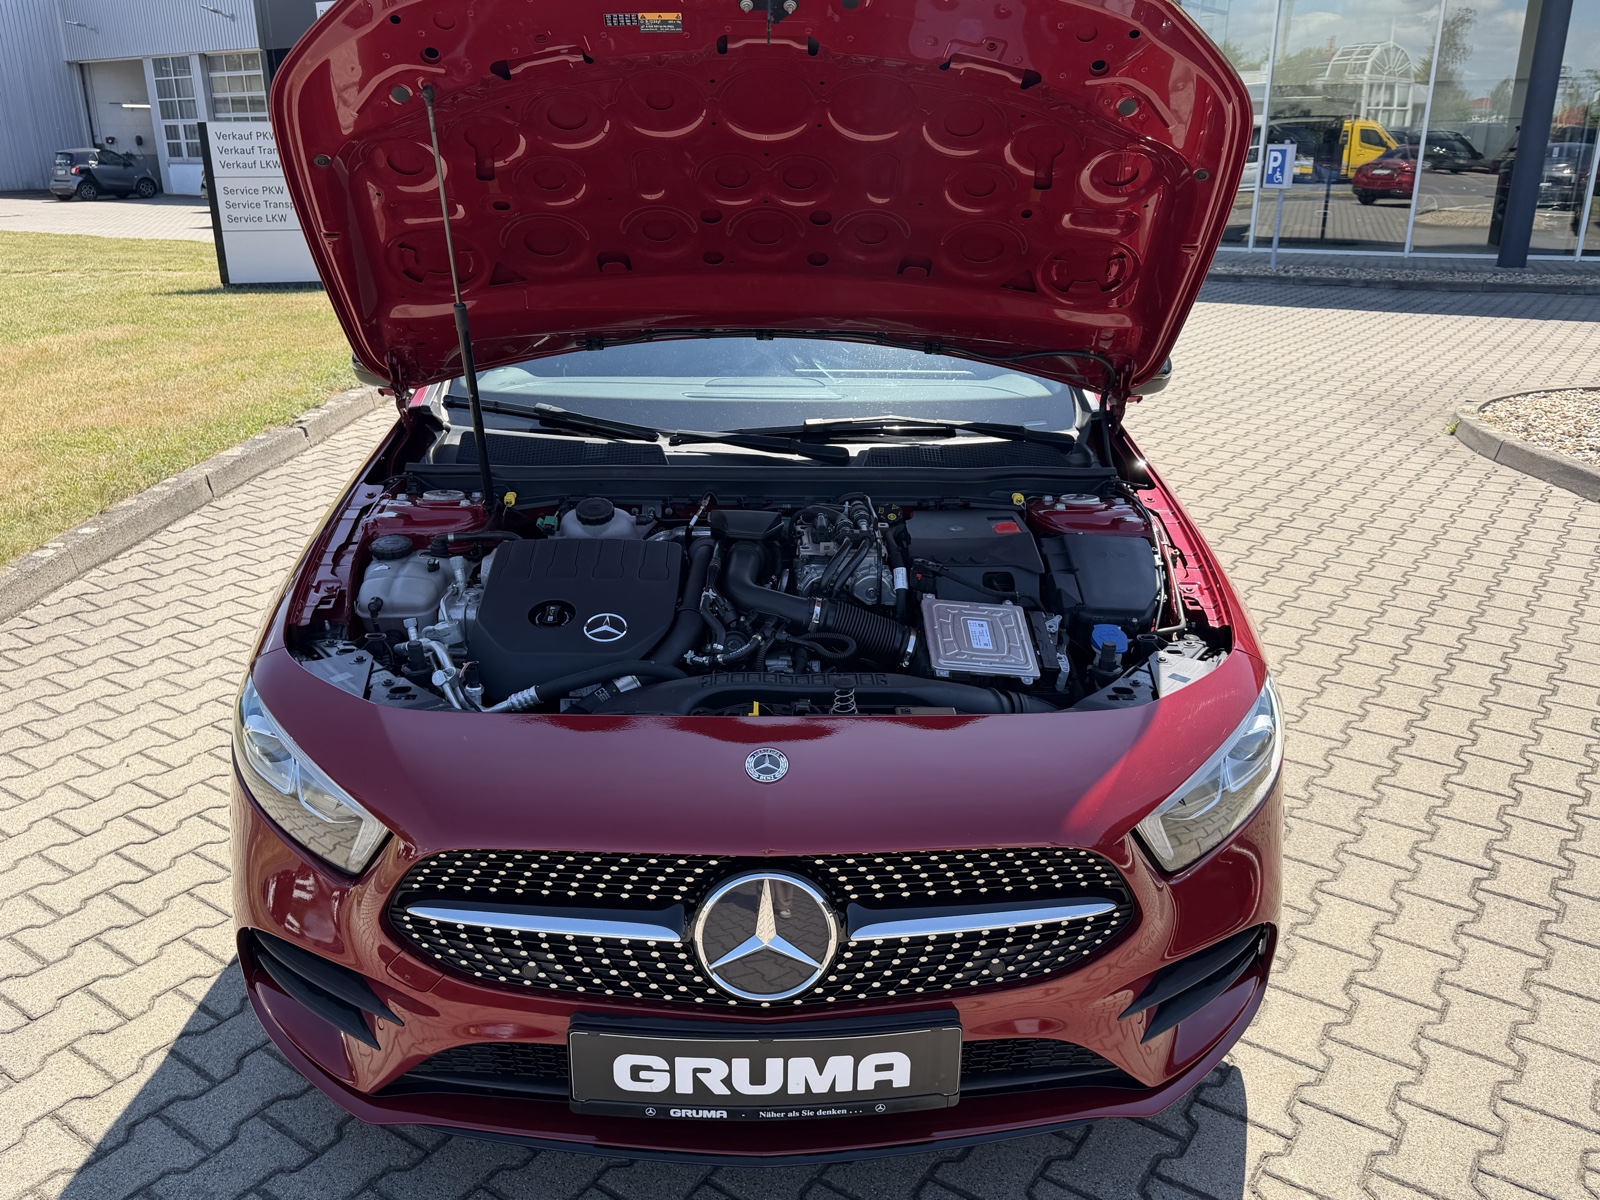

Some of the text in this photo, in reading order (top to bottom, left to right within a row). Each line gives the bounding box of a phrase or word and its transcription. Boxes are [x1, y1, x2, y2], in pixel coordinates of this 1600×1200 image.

[215, 131, 253, 140] Verkauf
[217, 146, 255, 154] Verkauf
[219, 160, 280, 169] Verkauf LKW
[1268, 151, 1282, 174] P
[223, 186, 284, 195] Service PKW
[225, 200, 261, 209] Service
[227, 214, 287, 223] Service LKW
[612, 1051, 912, 1095] GRUMA
[670, 1108, 728, 1118] GRUMA
